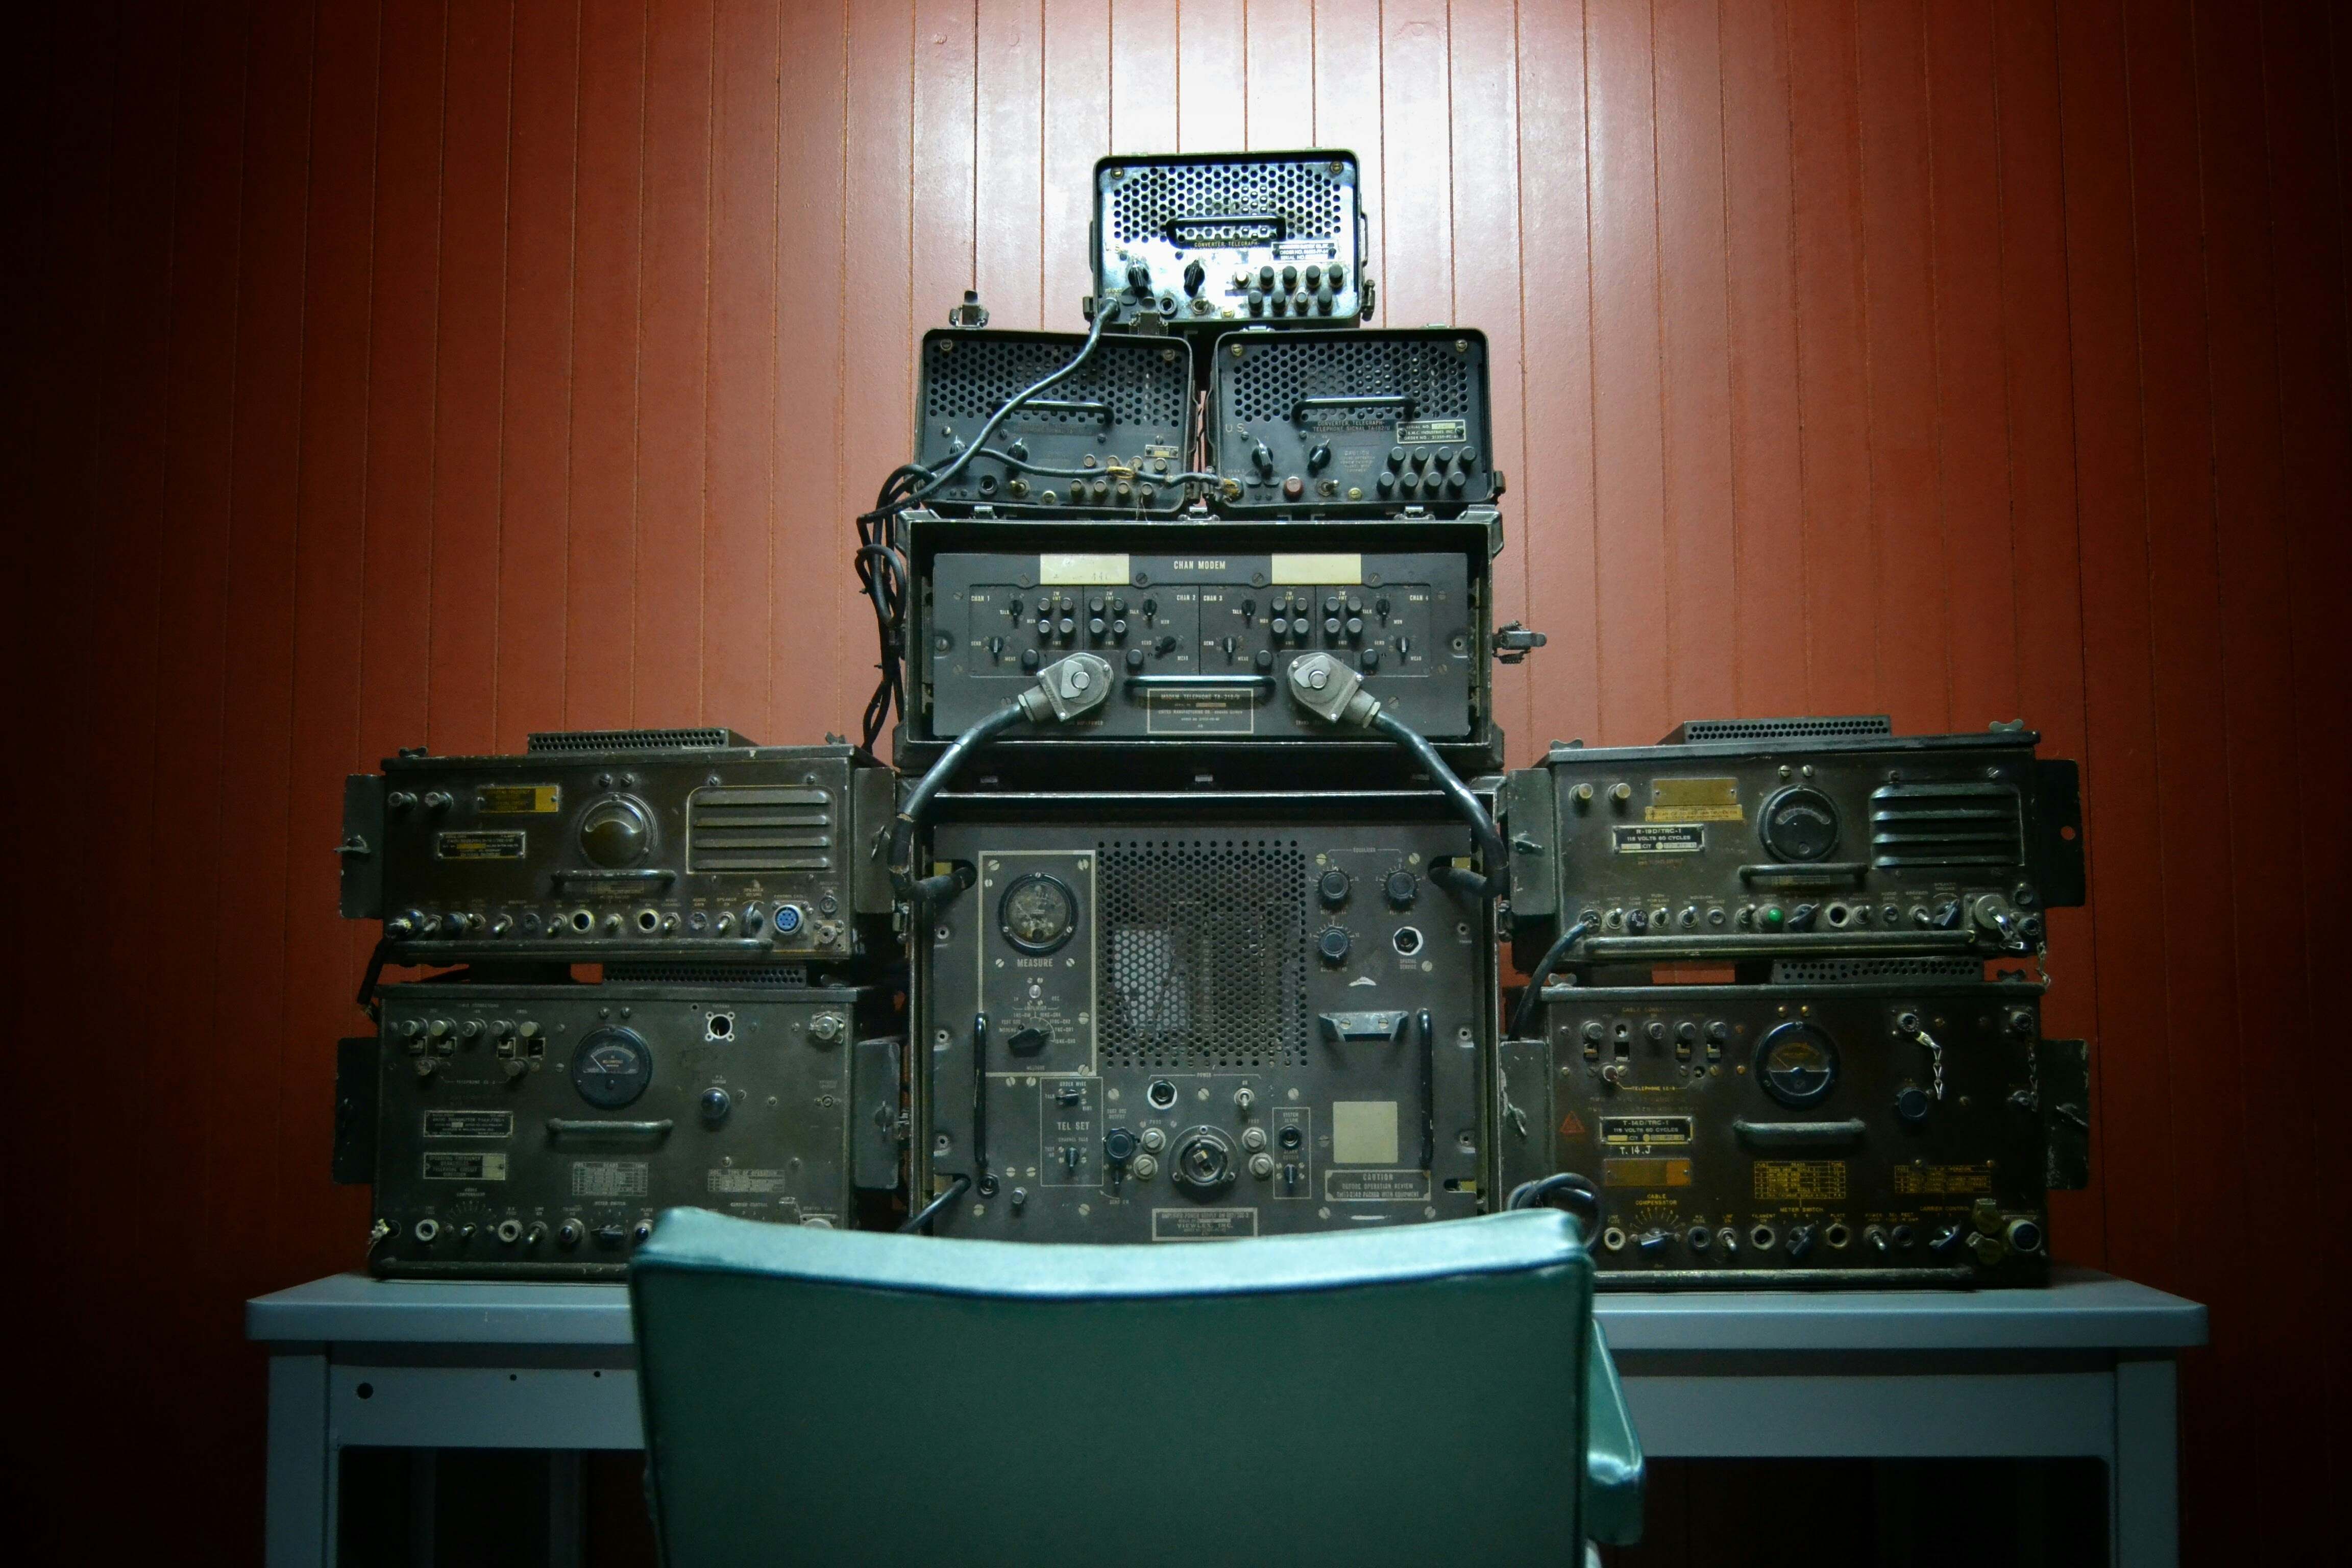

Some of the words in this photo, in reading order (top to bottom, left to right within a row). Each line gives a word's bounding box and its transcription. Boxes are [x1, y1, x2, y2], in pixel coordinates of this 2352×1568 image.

[1226, 424, 1233, 432] U
[1237, 423, 1244, 432] S
[1174, 560, 1194, 570] CHAN
[1198, 560, 1226, 570] MODEM
[1017, 958, 1053, 967] MEASURE
[1057, 1121, 1071, 1131] TEL
[1075, 1121, 1090, 1131] SET
